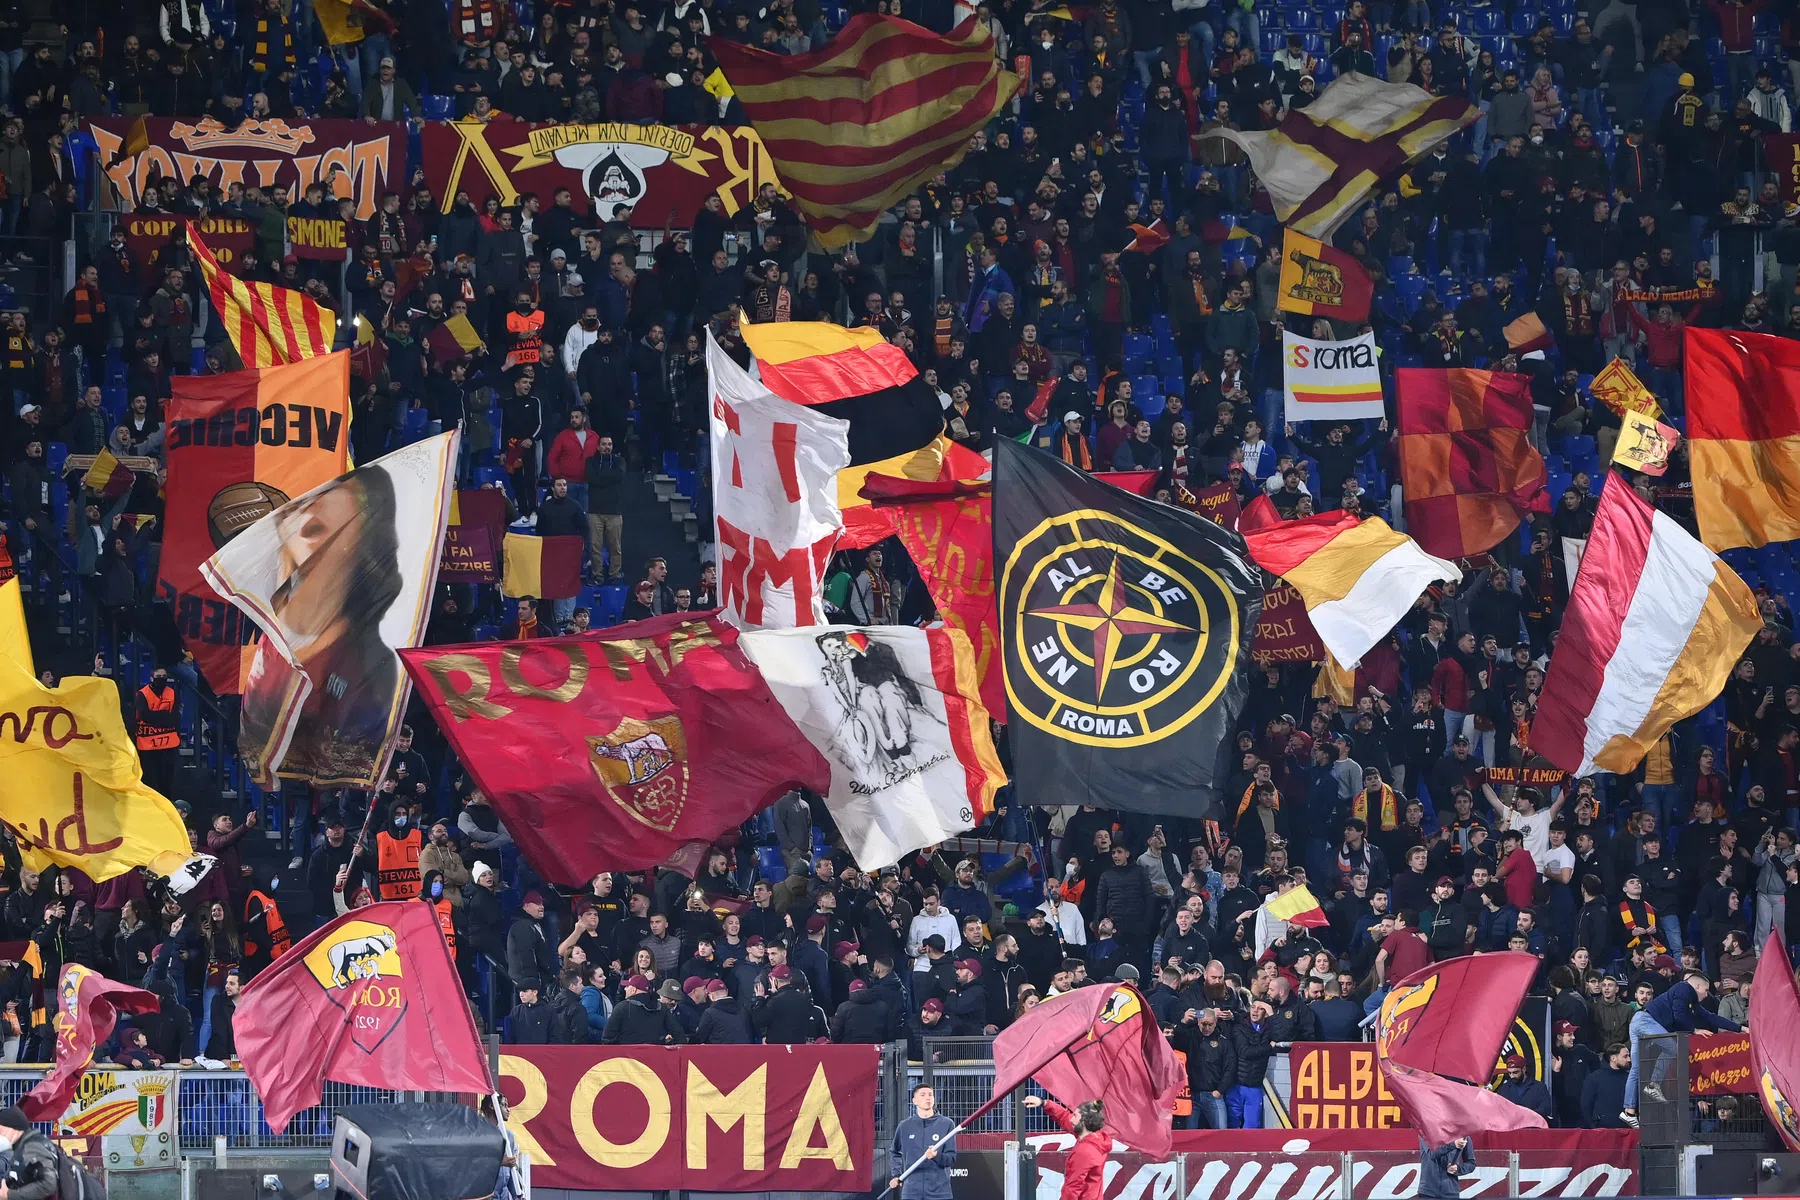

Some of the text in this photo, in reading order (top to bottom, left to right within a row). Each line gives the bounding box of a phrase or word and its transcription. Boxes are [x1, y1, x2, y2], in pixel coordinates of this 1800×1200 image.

[637, 124, 693, 154] ODERINT
[287, 216, 347, 249] SIMONE
[1662, 288, 1700, 301] MERDA
[519, 351, 536, 360] 166
[1314, 343, 1375, 370] roma
[1201, 486, 1232, 511] segui
[450, 546, 474, 557] FAI
[440, 561, 493, 572] PAZZIRE
[1262, 587, 1302, 611] QUE
[1251, 643, 1315, 661] AREMO!
[422, 620, 722, 724] ROMA
[1060, 709, 1134, 736] ROMA
[150, 736, 170, 748] 177
[1489, 768, 1515, 781] OMA
[379, 870, 422, 882] STEWAR
[394, 883, 415, 895] 161
[1689, 1039, 1750, 1064] rimavera
[497, 1054, 855, 1171] ROMA
